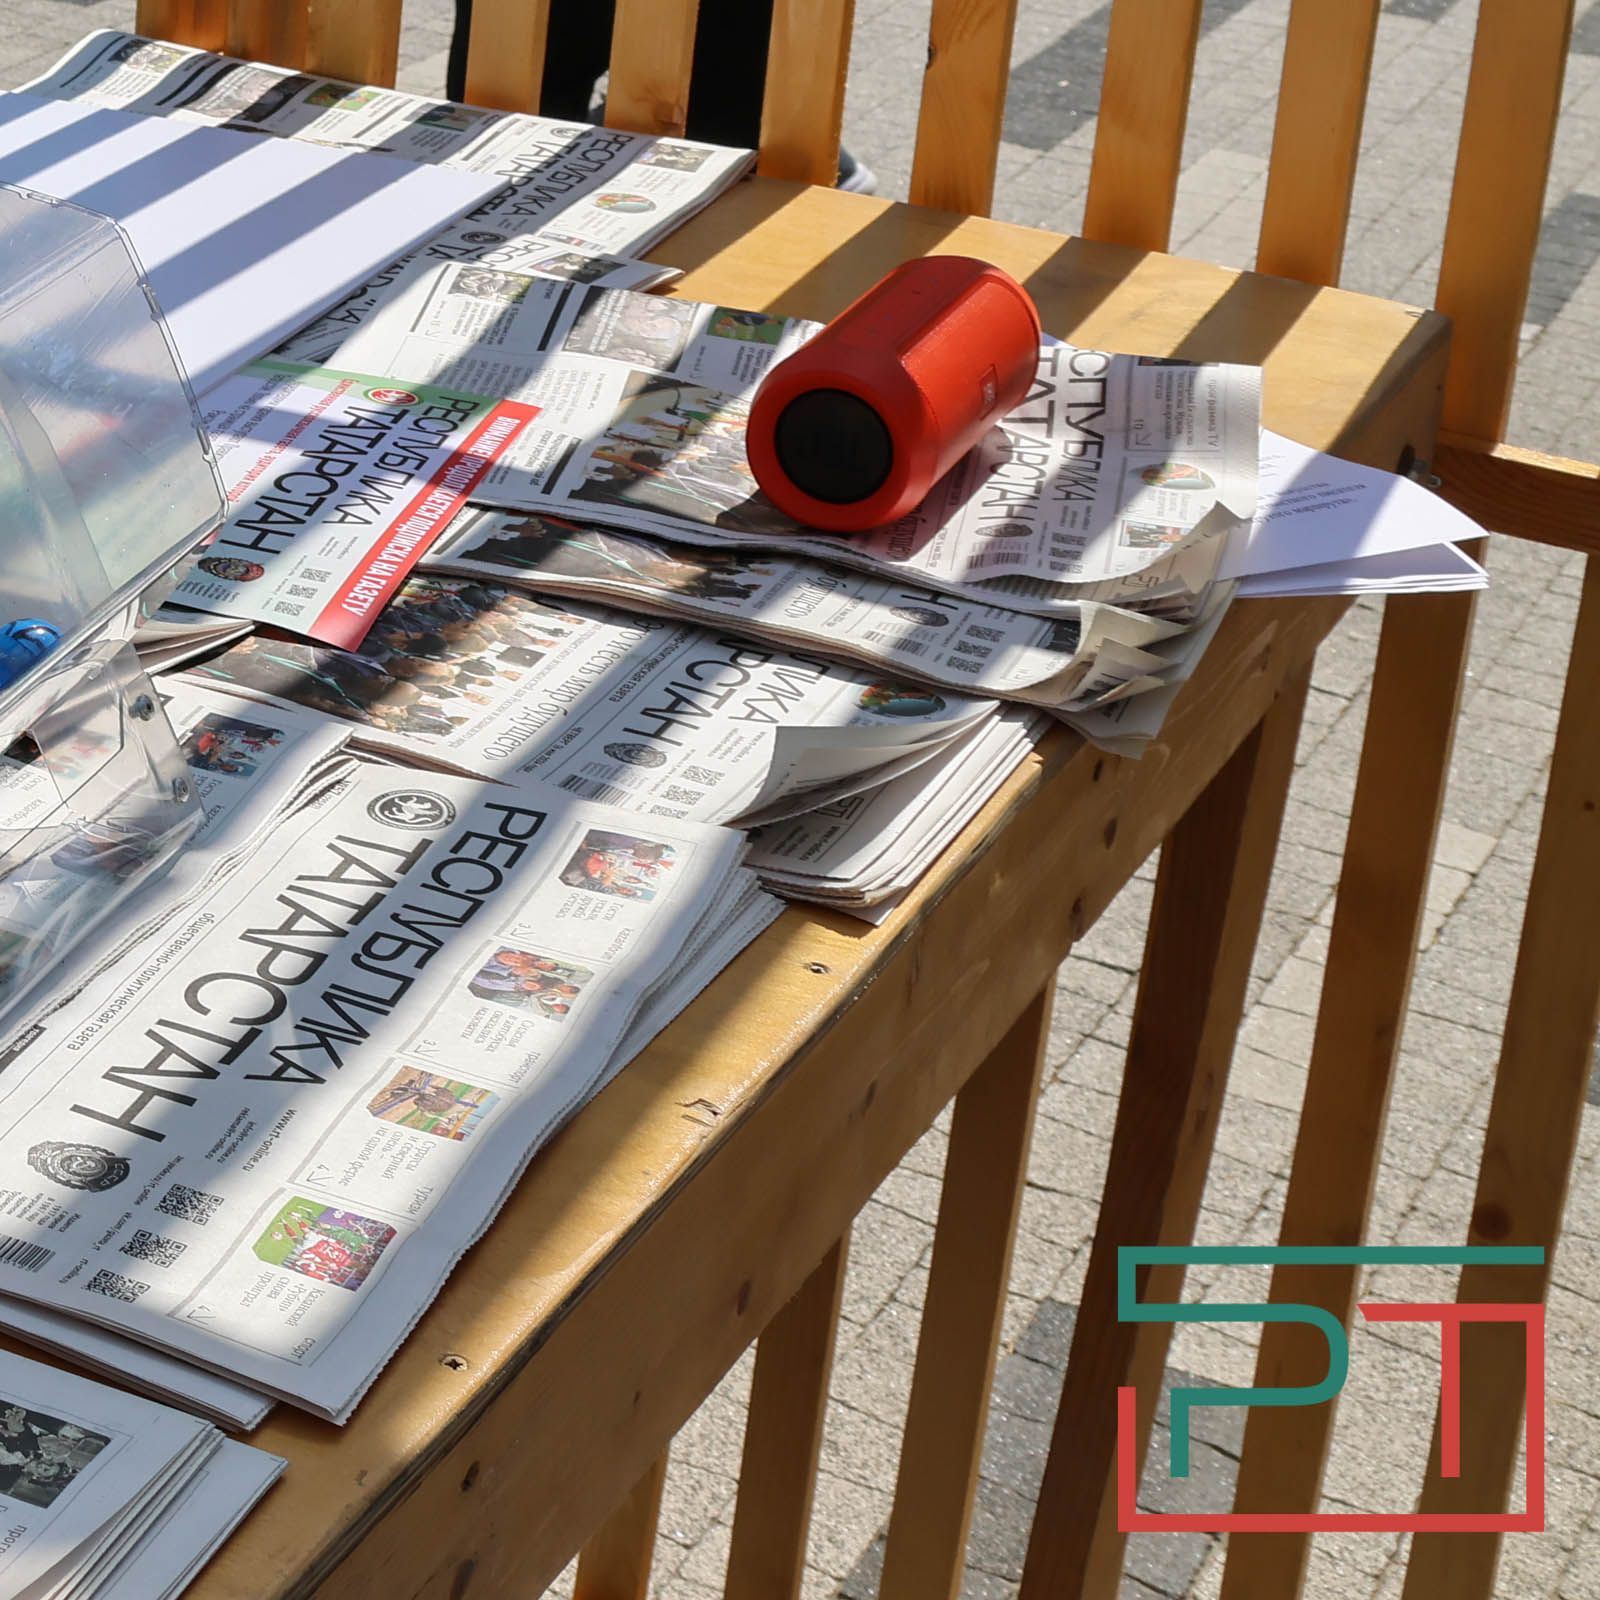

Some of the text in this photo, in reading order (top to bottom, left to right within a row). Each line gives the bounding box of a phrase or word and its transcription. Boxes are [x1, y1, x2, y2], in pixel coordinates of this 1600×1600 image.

[500, 131, 634, 220] РЕСПУБЛИКА
[466, 415, 520, 458] ВНИМАНИЕ!
[1048, 349, 1114, 504] СПУБЛИКА
[219, 396, 409, 559] ТАТАРСТАН
[321, 394, 479, 534] РЕСПУБЛИКА
[417, 453, 485, 519] ПРОДОЛЖАЕТСЯ
[365, 559, 394, 578] НА
[376, 514, 435, 564] ПОДПИСКА
[337, 574, 387, 616] ГАЗЕТУ
[465, 649, 626, 763] есть мир будущего»
[63, 821, 437, 1142] ТАТАРСТАН
[64, 911, 219, 1051] общественно-политическая газета
[243, 800, 548, 1098] РЕСПУБЛИКА
[239, 1107, 299, 1173] www.rt-online.ru
[402, 1139, 437, 1172] Страусы
[403, 1184, 436, 1215] туризм
[283, 1286, 325, 1328] Казанский
[288, 1335, 316, 1361] спорт
